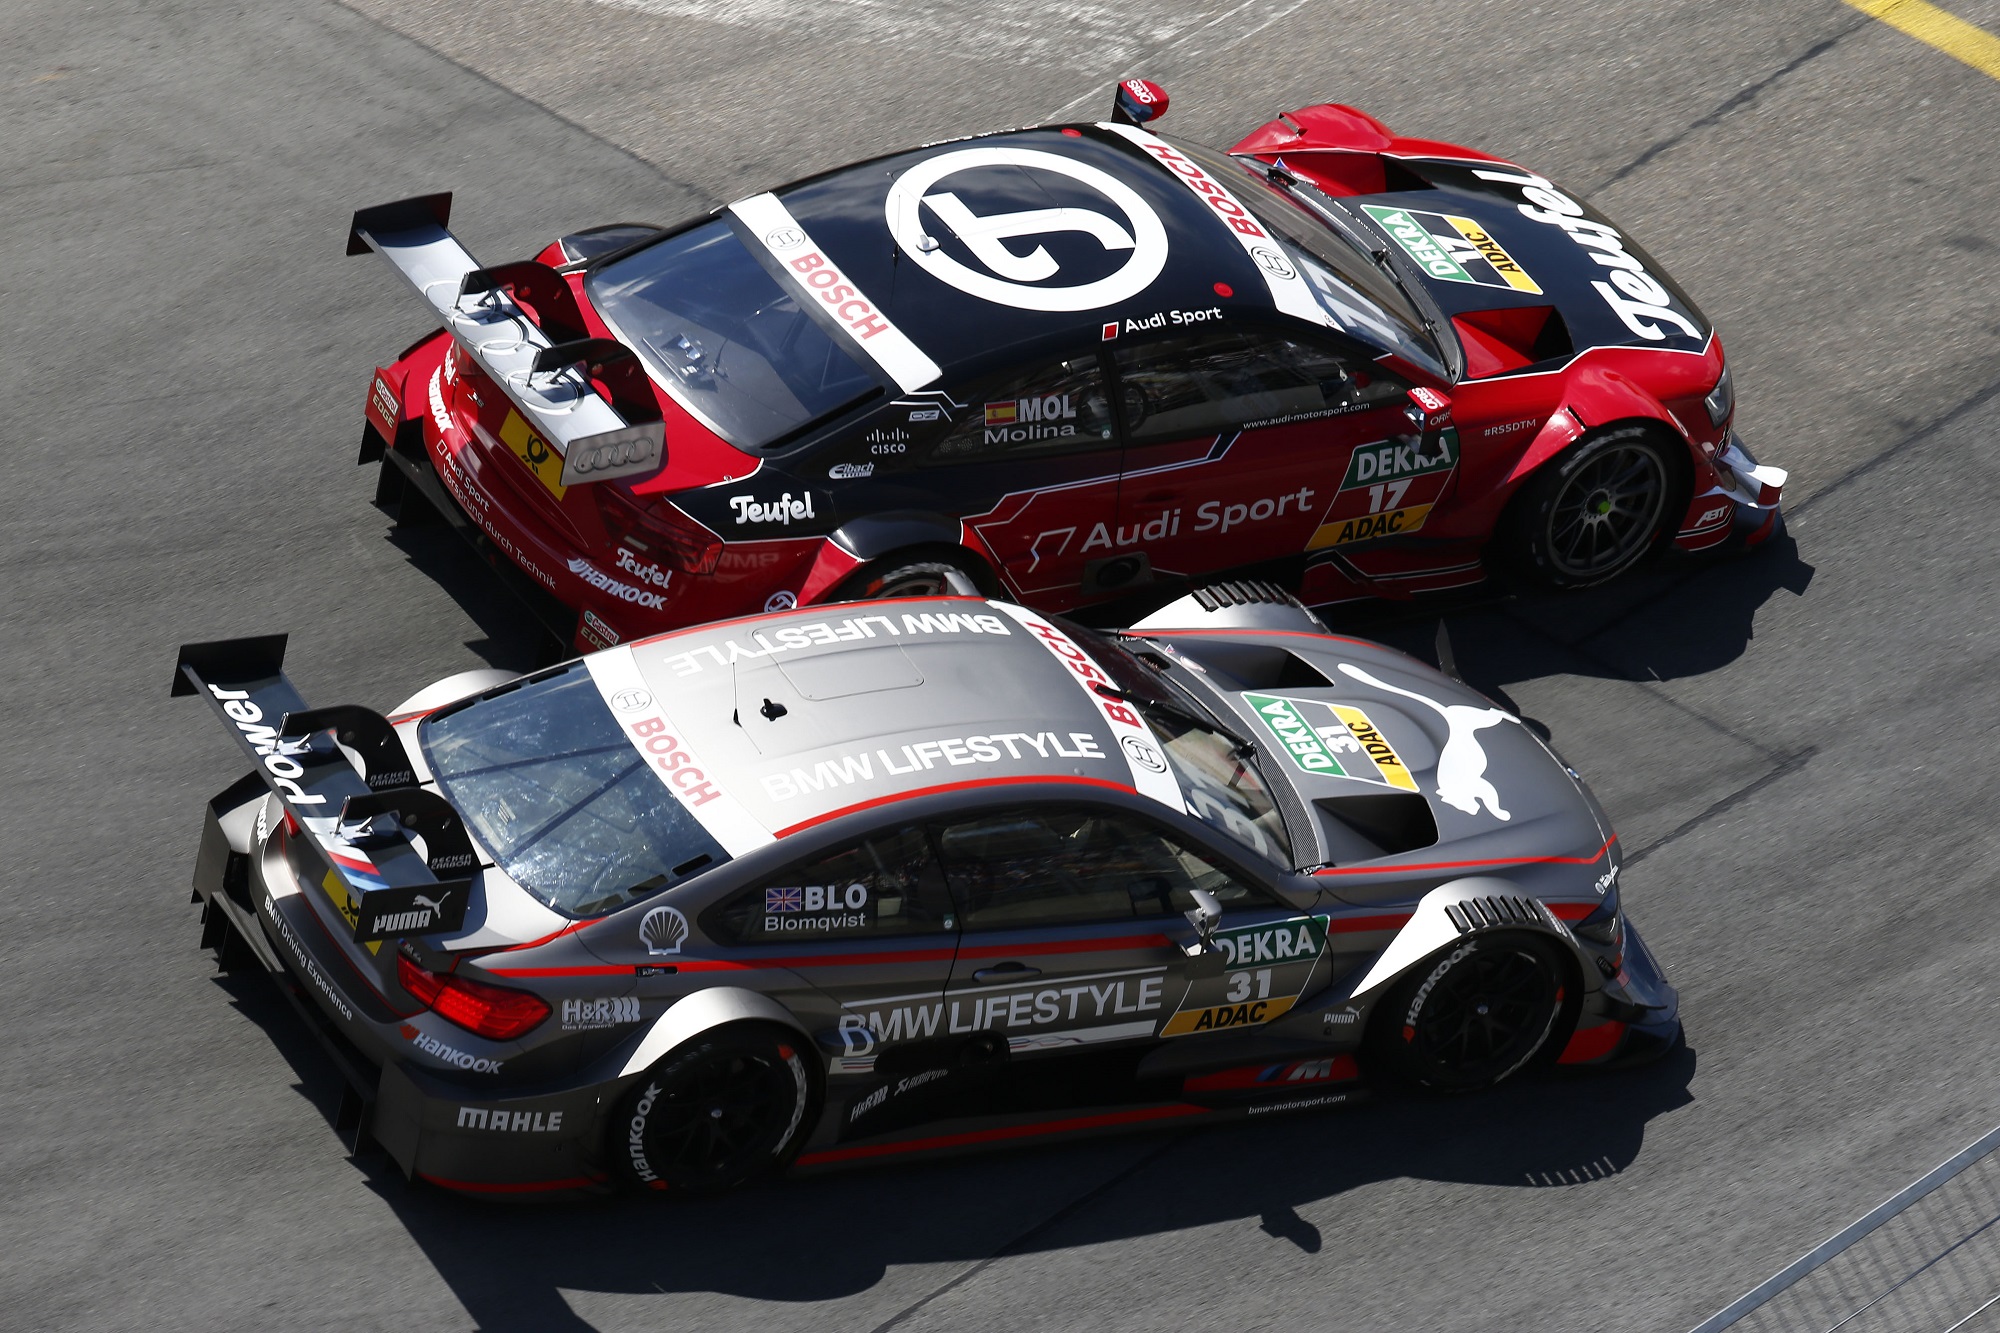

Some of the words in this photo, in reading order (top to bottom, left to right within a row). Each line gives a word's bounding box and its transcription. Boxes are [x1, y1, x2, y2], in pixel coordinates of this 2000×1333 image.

[1127, 80, 1152, 104] ORIS
[1142, 144, 1266, 239] BOSCH
[1382, 211, 1459, 275] DEKRA
[1431, 233, 1484, 264] 17
[1464, 232, 1521, 273] ADAC
[1471, 170, 1703, 340] Teufel
[790, 252, 889, 340] BOSCH
[1125, 312, 1167, 333] Audi
[1169, 307, 1223, 326] Sport
[372, 393, 394, 429] EDGE
[1019, 394, 1077, 423] MOL
[1411, 387, 1438, 409] ORIS
[1243, 402, 1370, 430] www.audi-motorsport.com
[1484, 418, 1537, 437] #RS5DTM
[984, 424, 1076, 445] Molina
[445, 451, 464, 481] Audi
[463, 477, 490, 513] Sport
[828, 461, 875, 479] Eibach
[729, 490, 816, 526] Teufel
[1368, 478, 1414, 514] 17
[443, 462, 484, 525] Vorsprung
[485, 520, 514, 553] durch
[515, 547, 556, 590] Technik
[1080, 508, 1182, 553] Audi
[1193, 486, 1315, 534] Sport
[1336, 510, 1405, 544] ADAC
[1694, 504, 1729, 527] ABT
[616, 547, 673, 589] Teufel
[580, 625, 609, 650] EDG
[591, 616, 619, 644] Castrol
[901, 613, 1012, 636] BMW
[663, 615, 901, 678] LIFESTYLE
[1024, 621, 1143, 729] BOSCH
[1260, 699, 1335, 769] DEKRA
[1315, 725, 1360, 754] 31
[1347, 721, 1401, 766] ADAC
[630, 716, 722, 807] BOSCH
[759, 752, 878, 801] BMW
[877, 731, 1106, 777] LIFESTYLE
[804, 883, 868, 911] BLO
[372, 910, 432, 934] PUMA
[764, 911, 866, 932] Blomqvist
[264, 894, 284, 929] BMW
[281, 923, 308, 968] Driving
[307, 958, 353, 1020] Experience
[1226, 968, 1272, 1003] 31
[561, 999, 614, 1024] H&R
[839, 1003, 944, 1058] BMW
[949, 976, 1165, 1034] LIFESTYLE
[1193, 1001, 1268, 1032] ADAC
[1323, 1012, 1355, 1024] PUMA
[1285, 1058, 1337, 1081] M
[457, 1106, 563, 1132] MAHLE
[1248, 1094, 1347, 1115] bmw-motorsport.com
